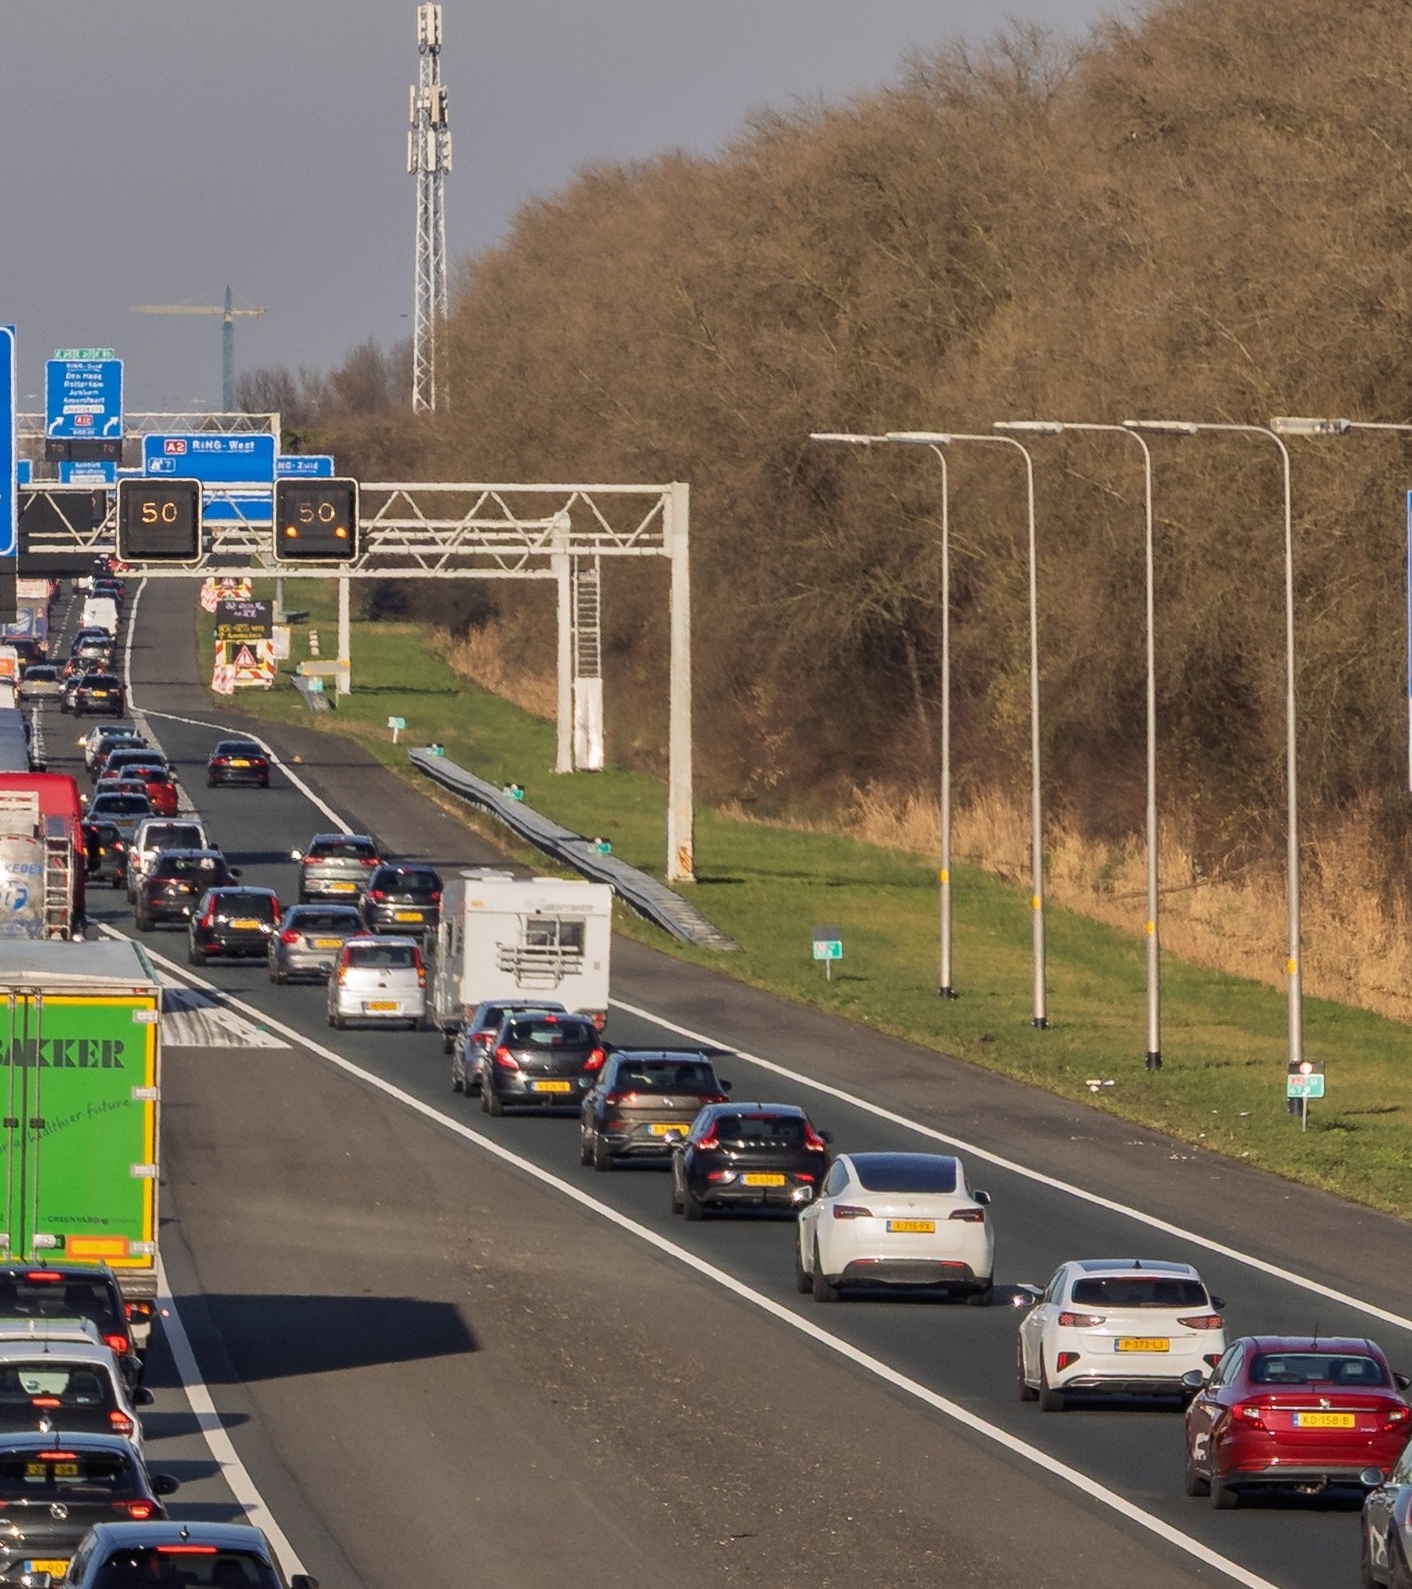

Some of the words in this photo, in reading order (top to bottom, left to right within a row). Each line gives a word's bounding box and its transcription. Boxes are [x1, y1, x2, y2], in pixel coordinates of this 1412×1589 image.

[166, 442, 185, 452] A2
[141, 502, 178, 523] 50
[299, 502, 336, 523] 50
